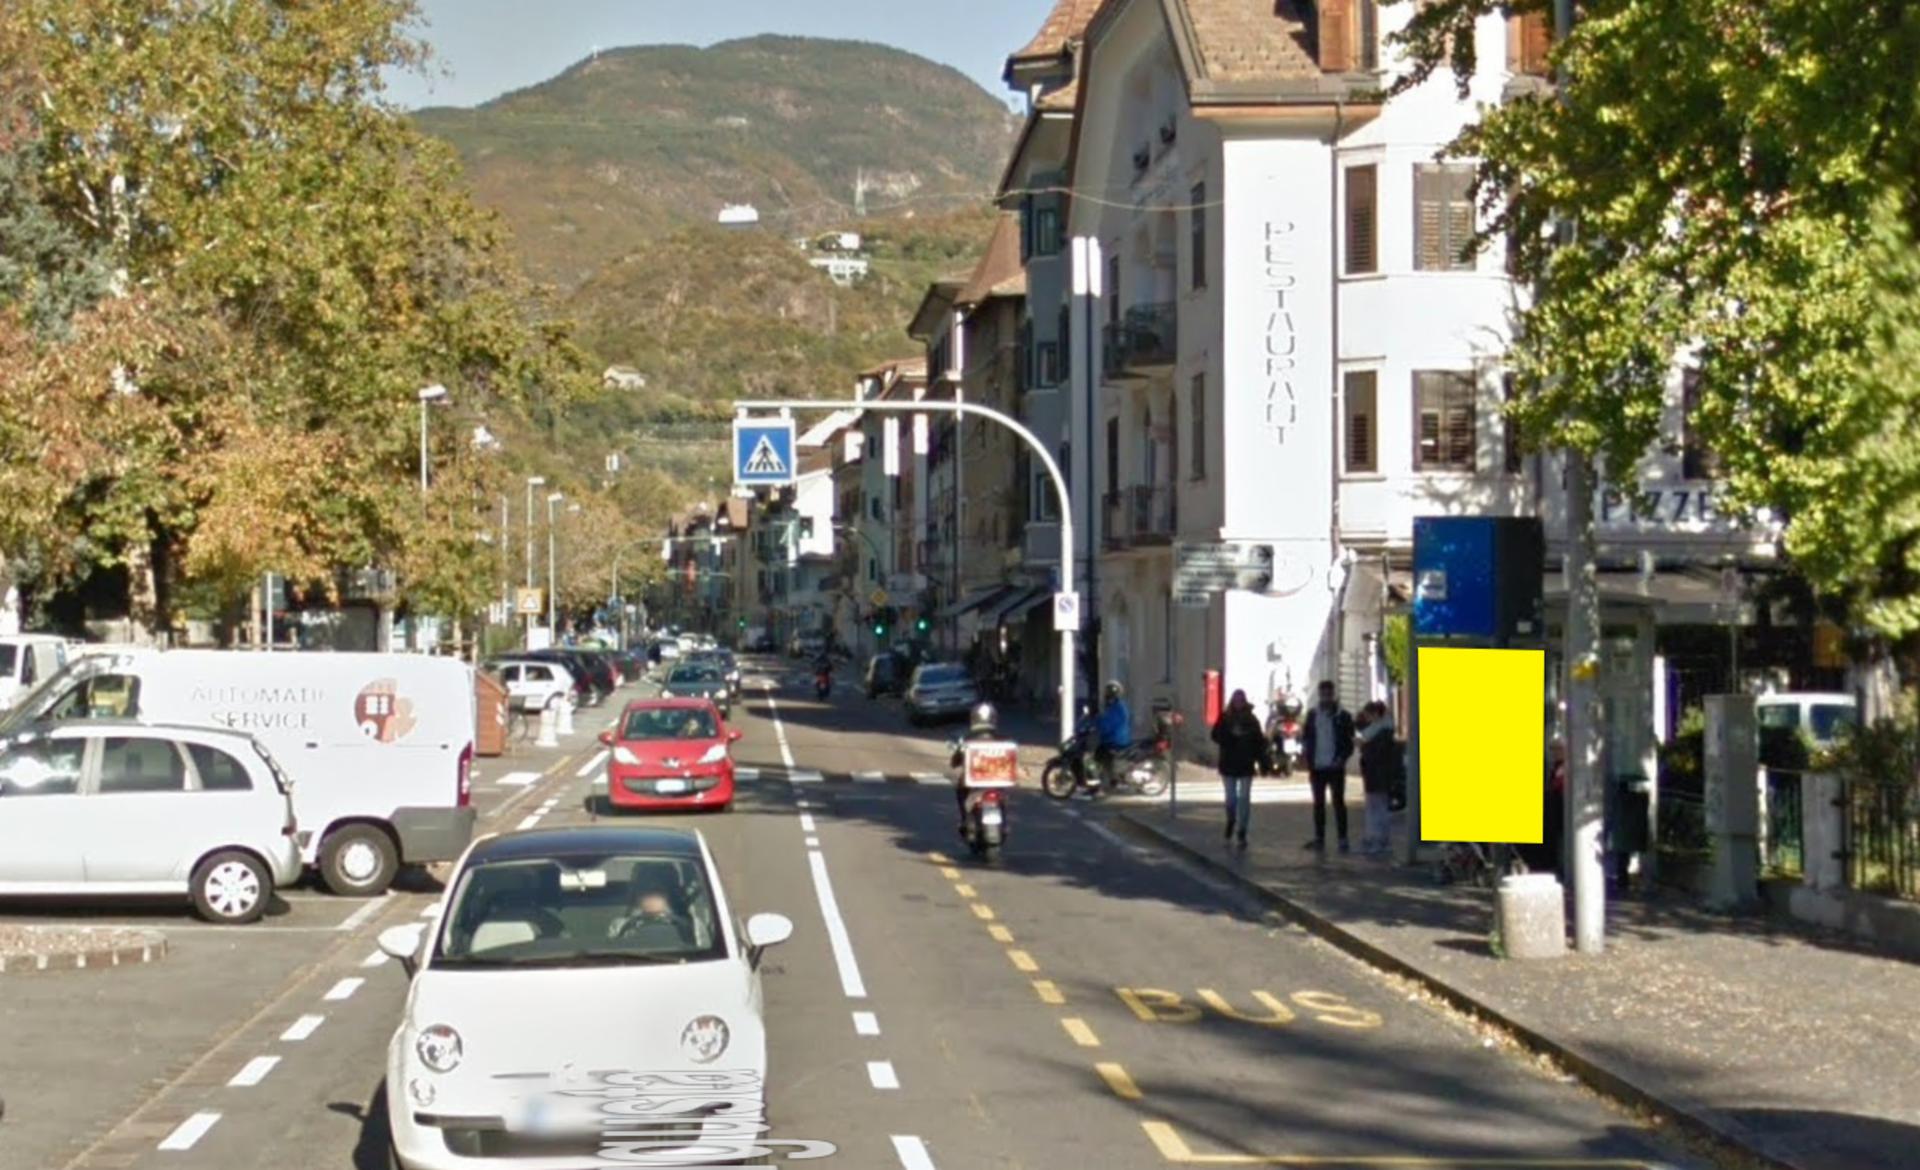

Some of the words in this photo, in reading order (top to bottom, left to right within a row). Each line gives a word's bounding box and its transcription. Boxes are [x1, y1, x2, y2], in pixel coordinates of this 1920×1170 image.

[1601, 488, 1722, 523] PIZZE
[210, 711, 310, 729] SERVICE
[1114, 988, 1384, 1028] BUS
